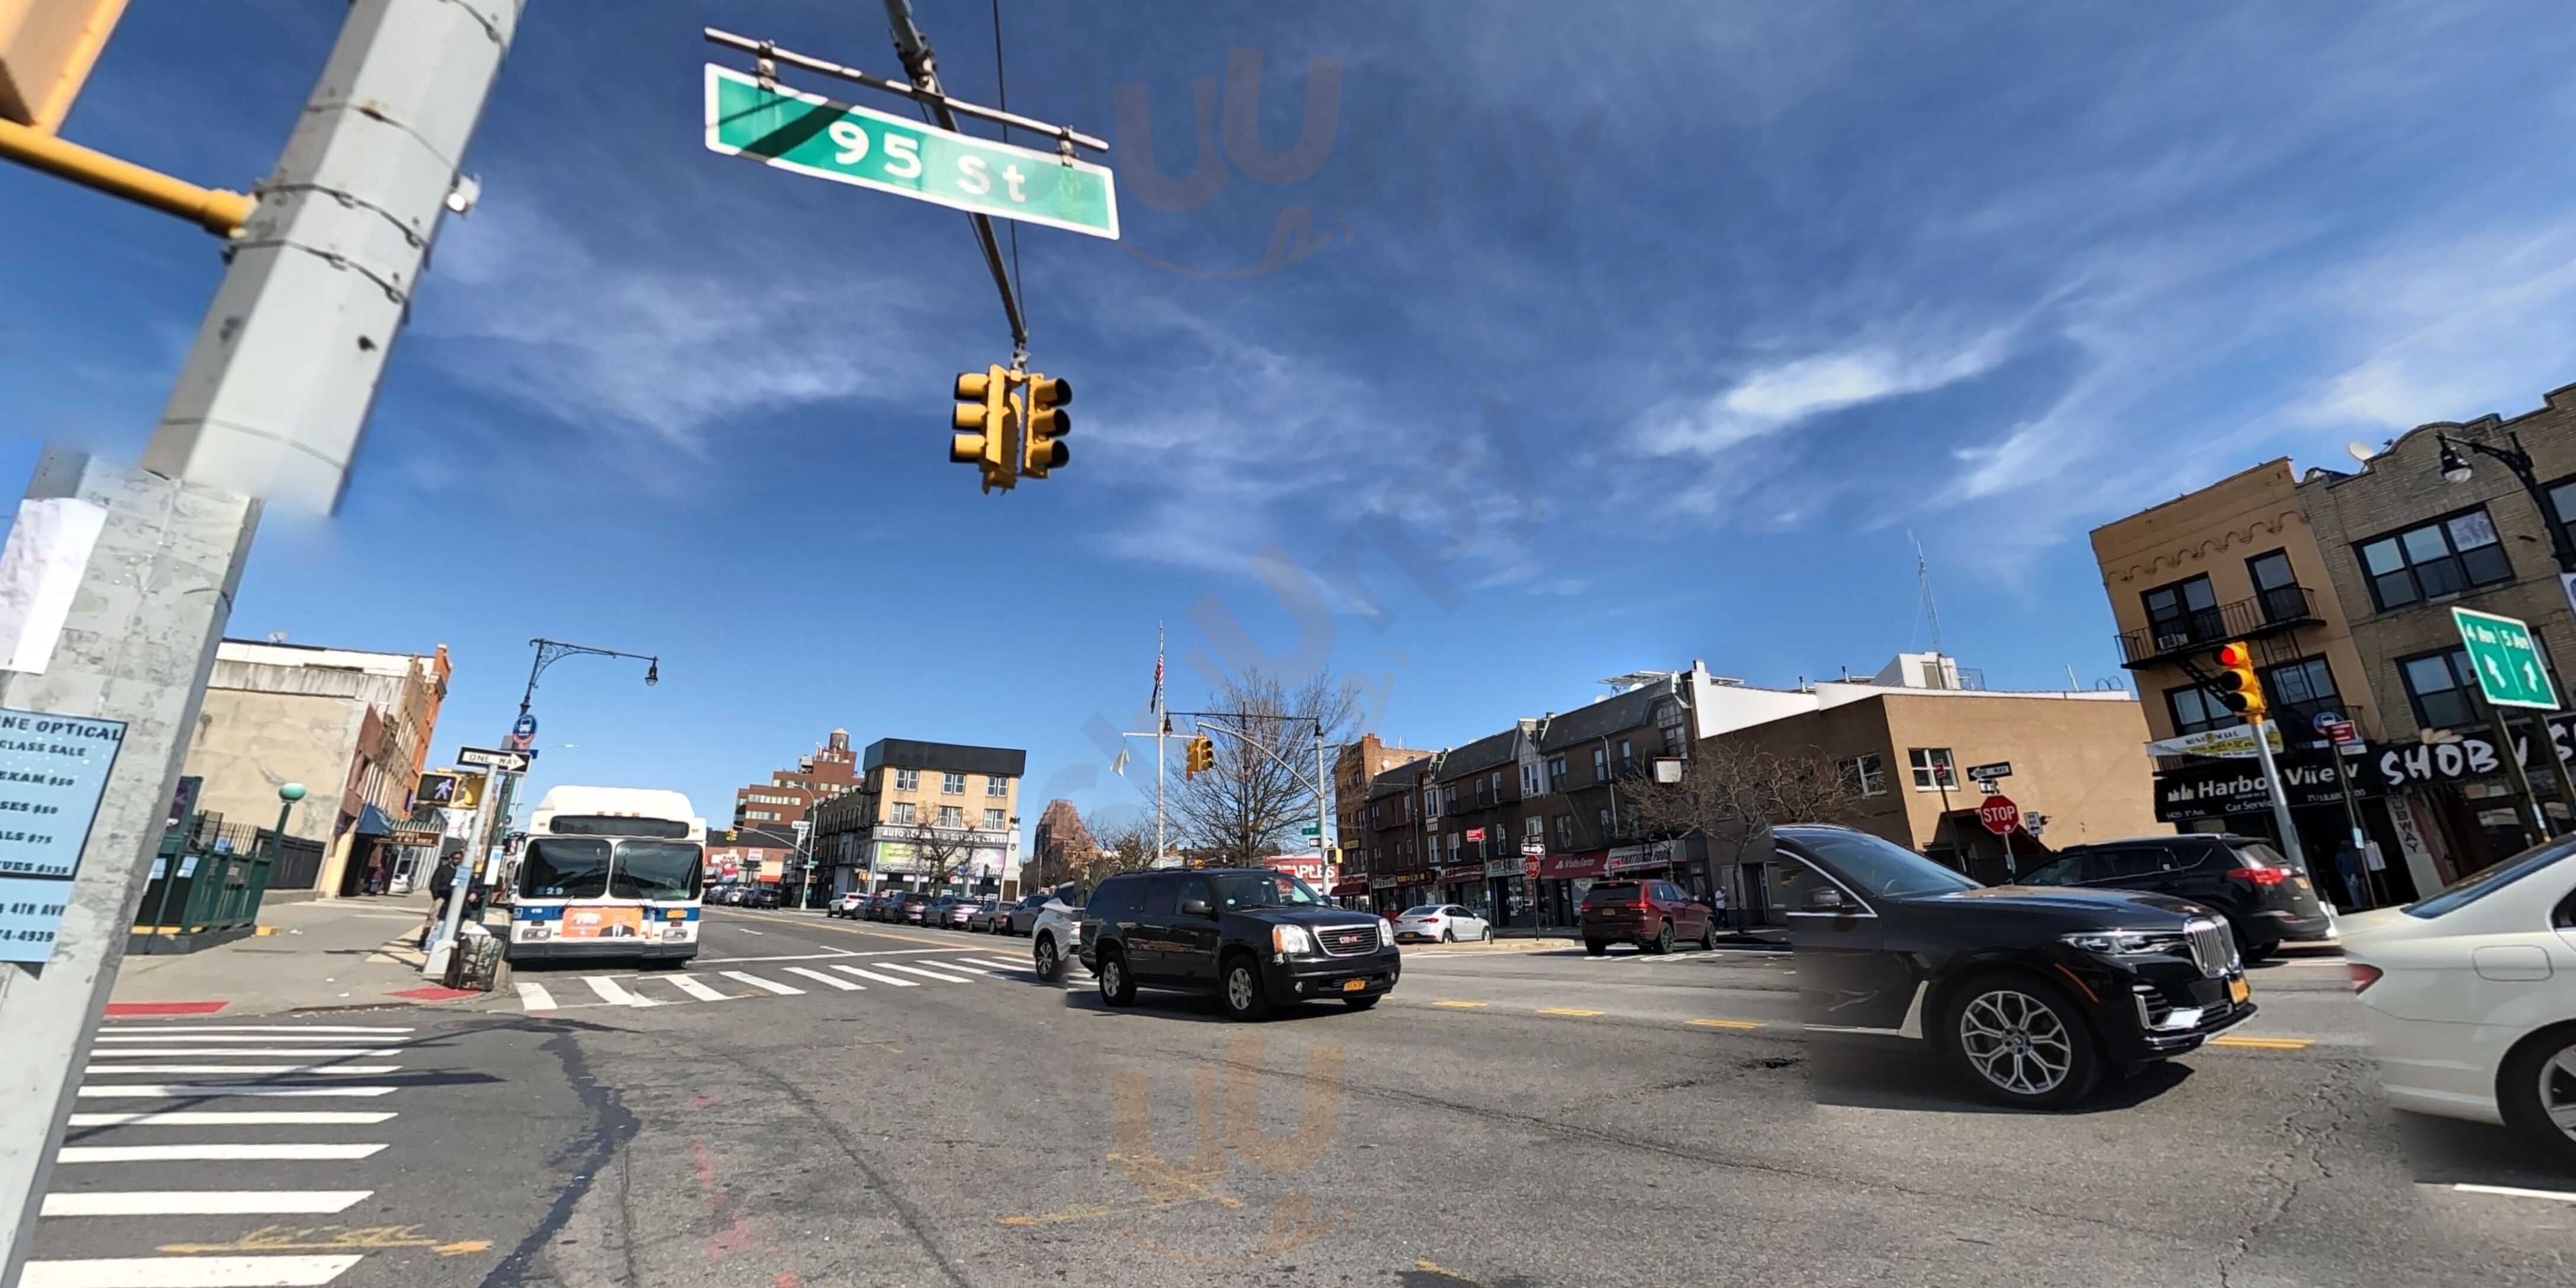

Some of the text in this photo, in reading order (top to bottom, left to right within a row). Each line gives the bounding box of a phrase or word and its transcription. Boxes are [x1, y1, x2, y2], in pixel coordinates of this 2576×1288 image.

[829, 120, 1026, 203] 95 St
[0, 716, 122, 740] NE OPTICAL
[49, 744, 86, 756] SALE
[469, 754, 520, 766] ONE WAY
[0, 771, 46, 784] EXAM
[2198, 775, 2280, 798] Harbo
[2225, 799, 2275, 812] Car Servic
[1983, 806, 2016, 823] STOP
[883, 829, 903, 838] AUTO
[1525, 862, 1539, 872] STOP
[546, 887, 564, 895] 29
